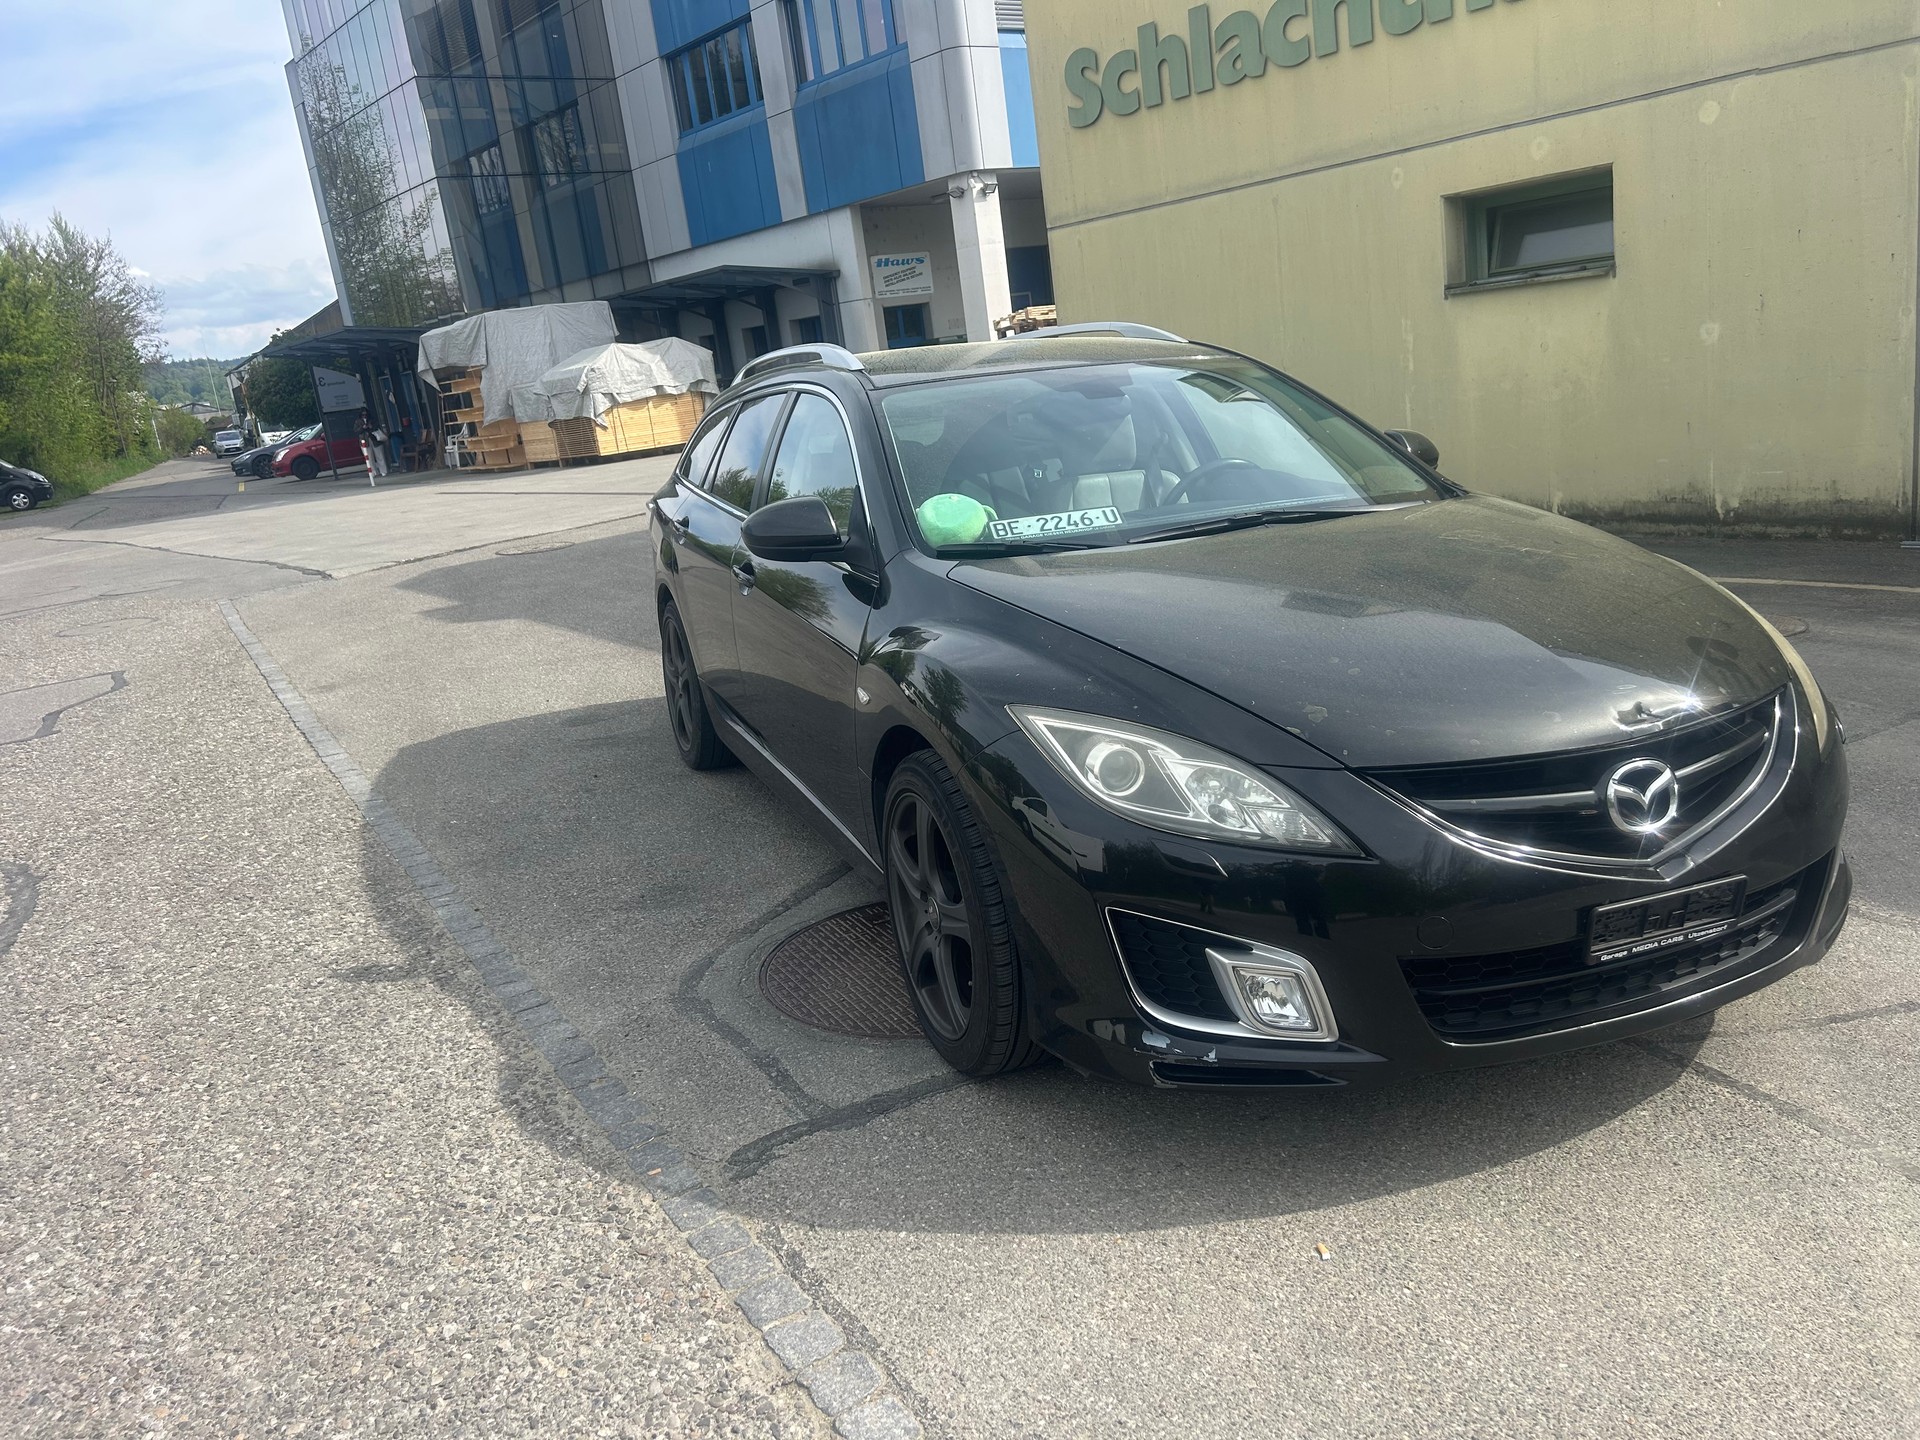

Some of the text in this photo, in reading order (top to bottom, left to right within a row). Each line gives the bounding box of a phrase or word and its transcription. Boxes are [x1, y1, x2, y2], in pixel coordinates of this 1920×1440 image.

[1064, 0, 1526, 128] Schlach
[875, 257, 926, 268] Haws
[1600, 924, 1728, 961] Garage MEDIA CARS Utzenstorf
